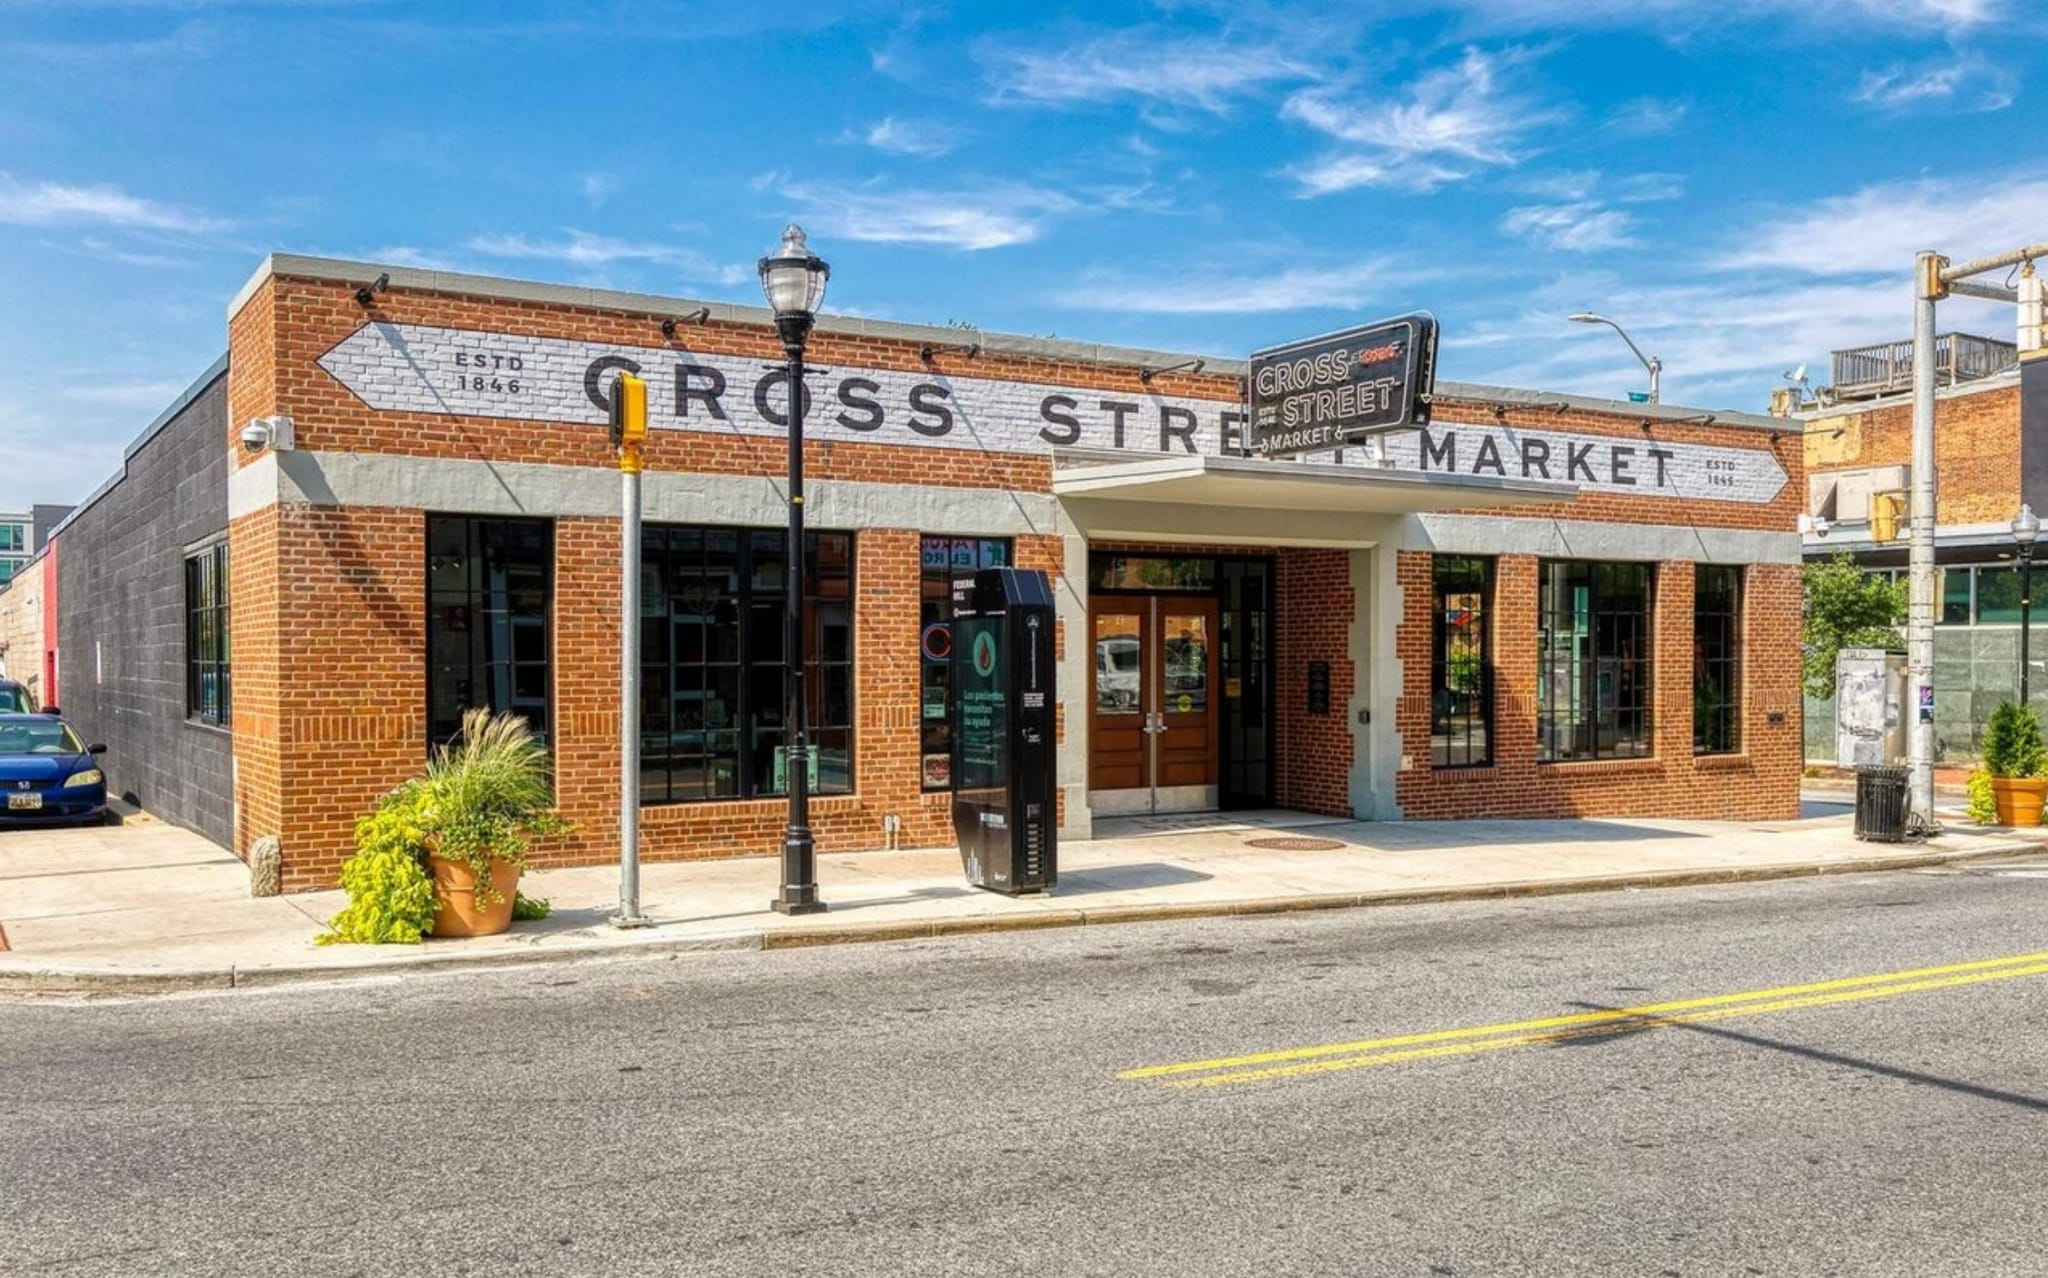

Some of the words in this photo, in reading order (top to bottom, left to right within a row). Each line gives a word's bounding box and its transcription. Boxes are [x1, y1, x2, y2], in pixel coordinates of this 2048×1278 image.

[455, 352, 523, 371] ESTD
[1256, 348, 1349, 396] CROSS
[458, 375, 520, 394] 1846
[1282, 377, 1397, 427] STREET
[583, 355, 953, 437] CROSS
[1419, 430, 1674, 487] MARKET
[1269, 427, 1331, 449] MARKET
[1706, 460, 1735, 471] ESTD
